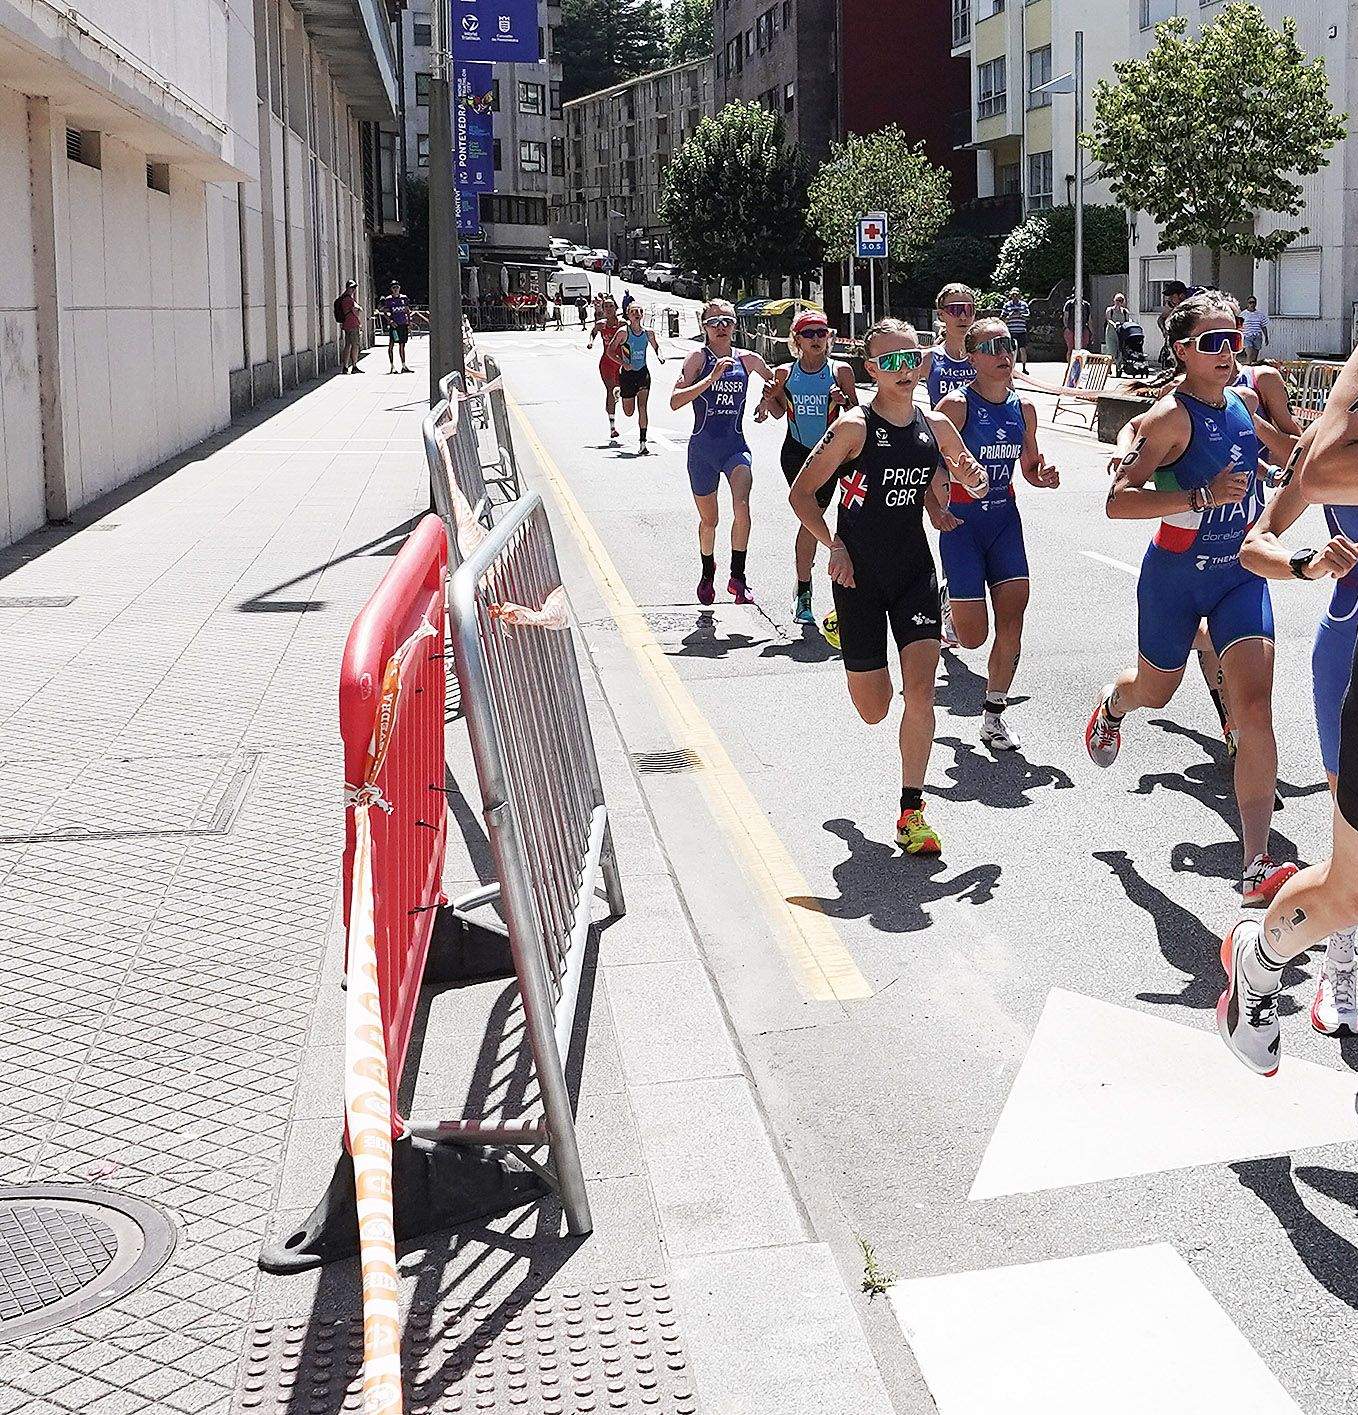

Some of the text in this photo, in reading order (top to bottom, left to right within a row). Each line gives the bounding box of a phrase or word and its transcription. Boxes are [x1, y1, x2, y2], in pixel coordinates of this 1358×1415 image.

[458, 103, 467, 168] PONTEVEDRA
[711, 380, 744, 392] WASSER
[715, 393, 735, 406] FRA
[793, 394, 827, 405] DUPONT
[797, 405, 824, 416] BEL
[979, 443, 1022, 460] PRIARONE
[881, 466, 931, 486] PRICE
[885, 488, 918, 507] GBR
